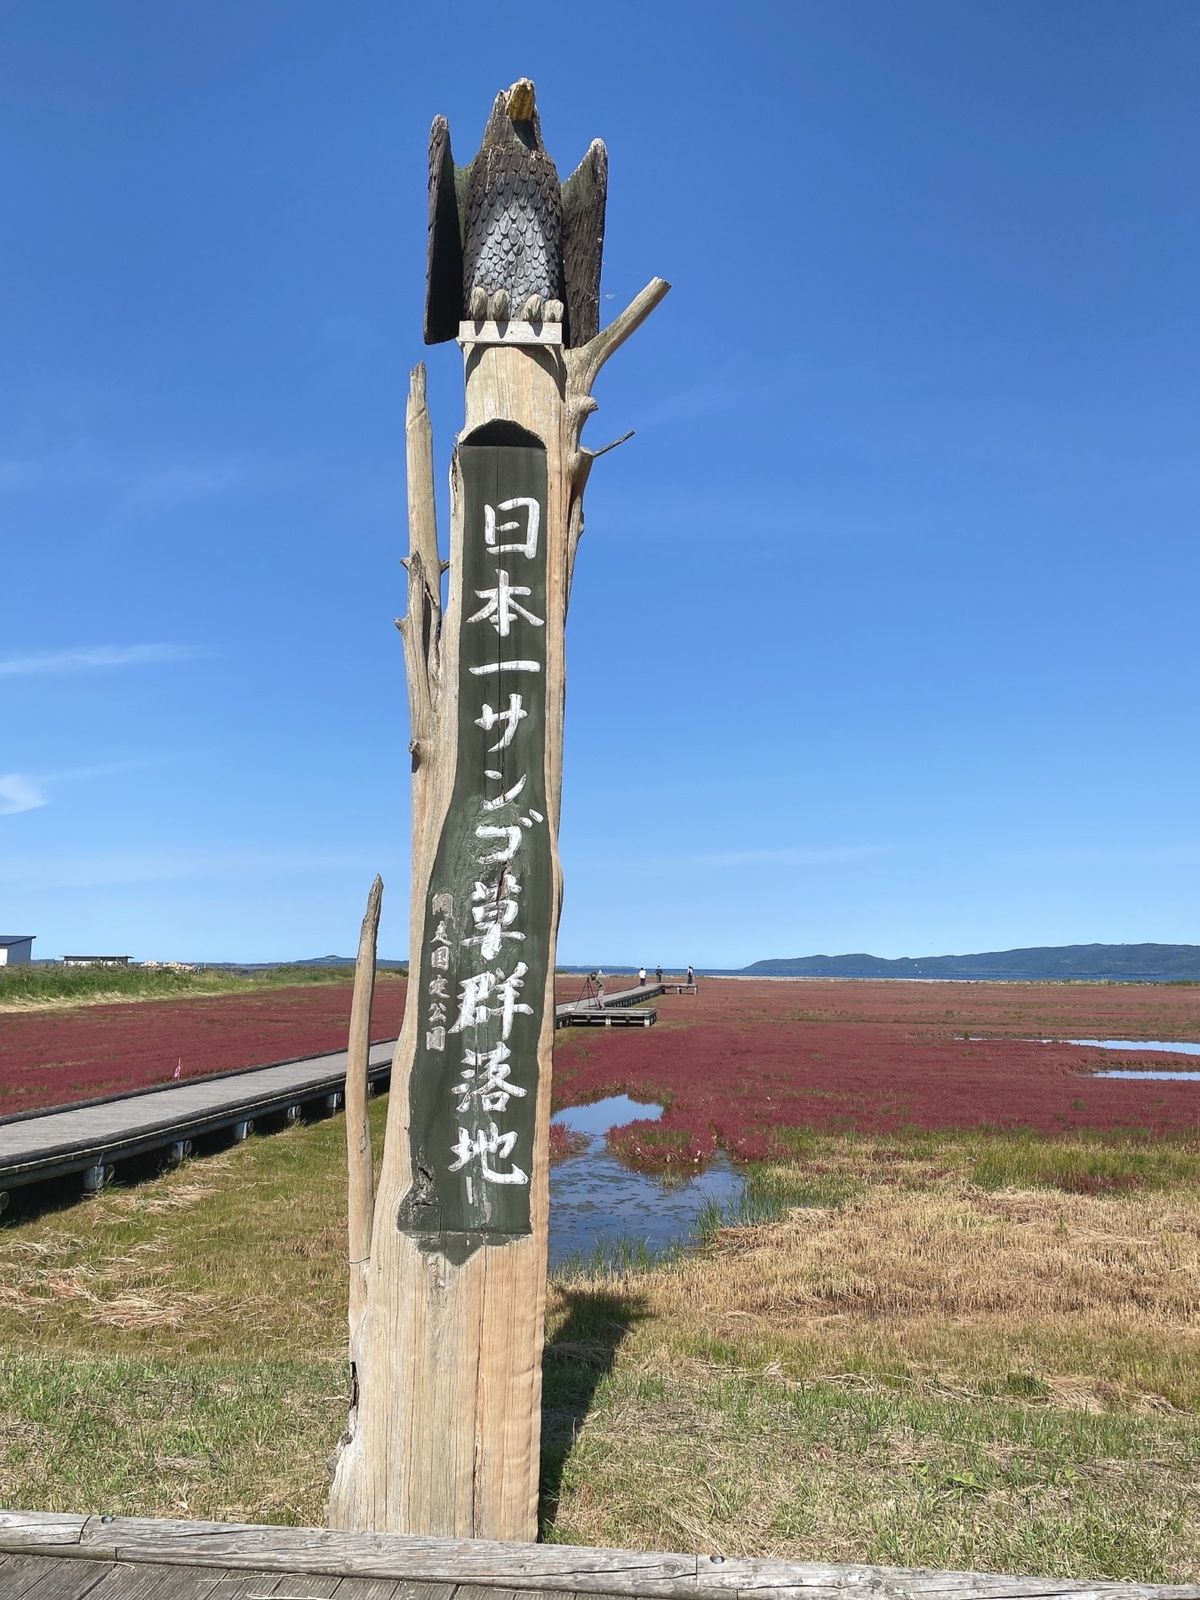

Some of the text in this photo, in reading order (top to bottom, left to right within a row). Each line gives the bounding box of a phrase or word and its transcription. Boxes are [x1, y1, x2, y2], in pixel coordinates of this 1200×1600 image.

[447, 497, 545, 1185] 日本一サンゴ草群落地
